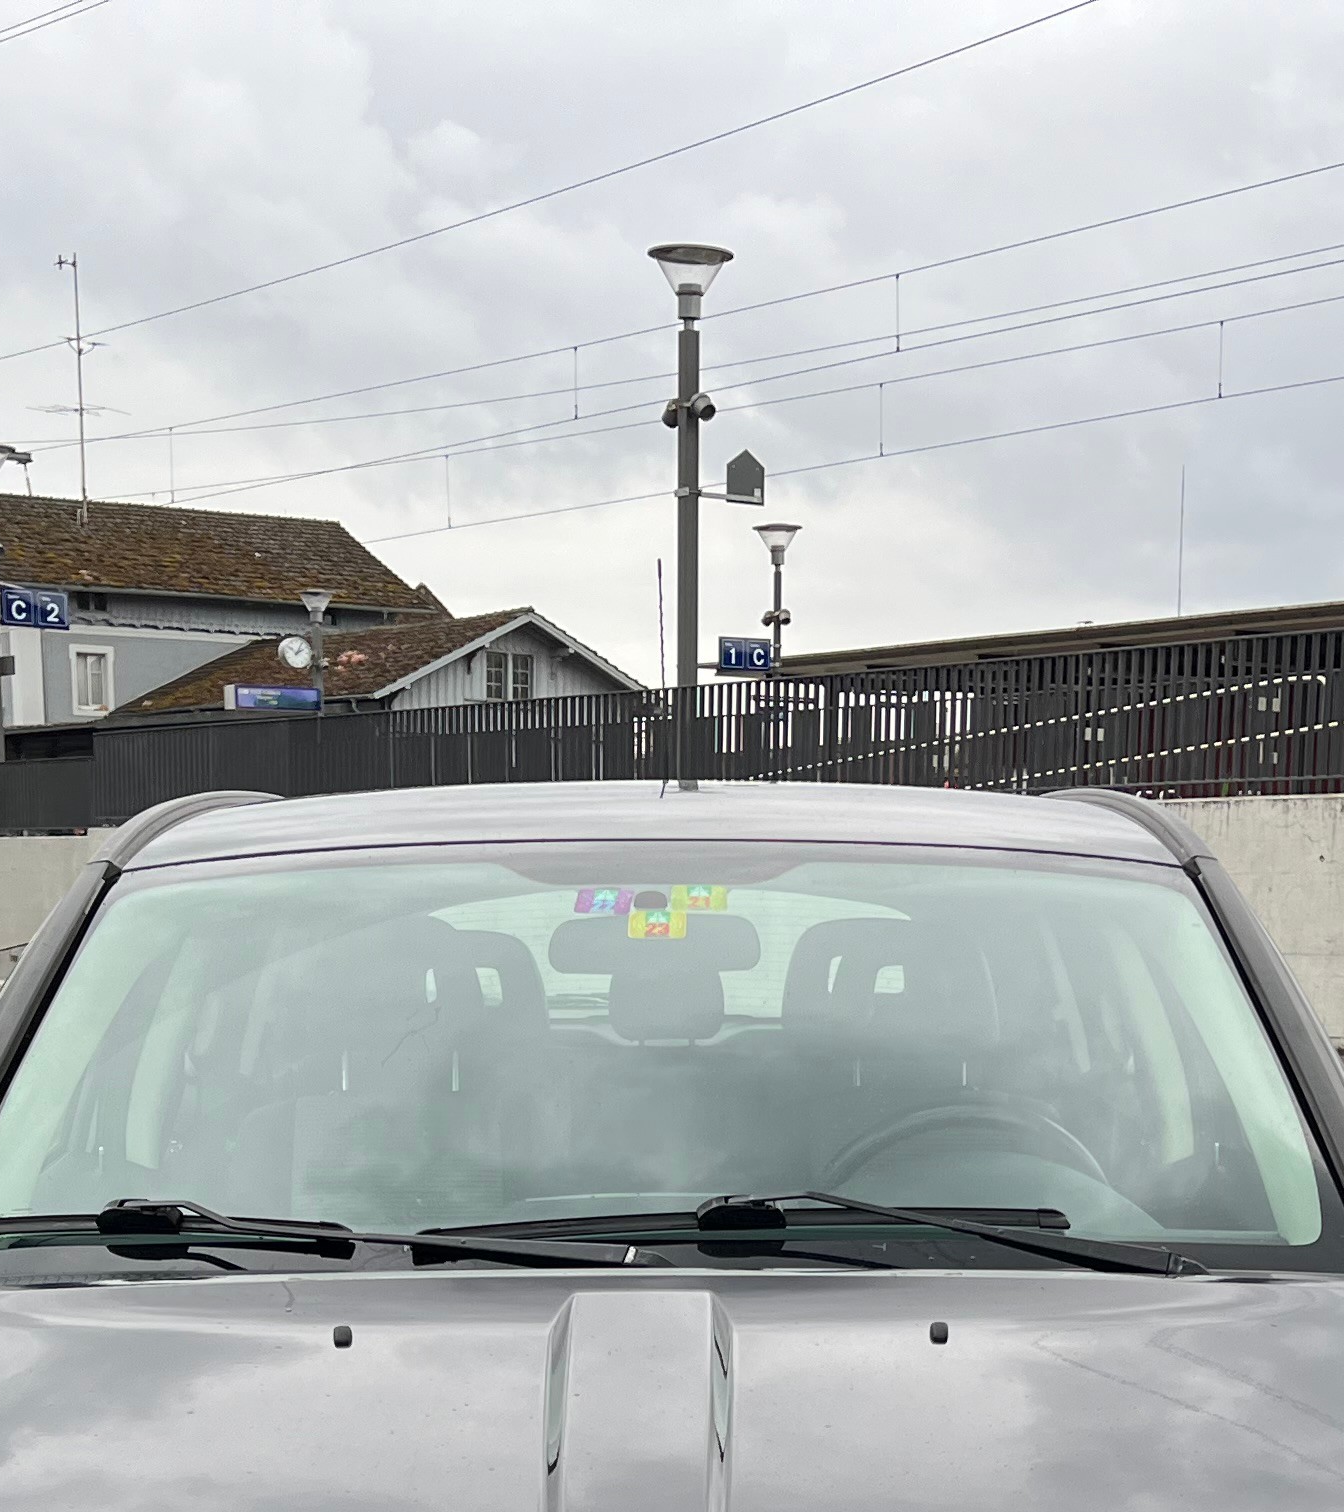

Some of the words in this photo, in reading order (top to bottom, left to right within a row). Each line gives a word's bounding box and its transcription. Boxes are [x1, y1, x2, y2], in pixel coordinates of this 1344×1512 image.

[11, 600, 27, 621] C
[46, 603, 60, 623] 2
[729, 647, 736, 665] 1
[752, 648, 765, 666] C
